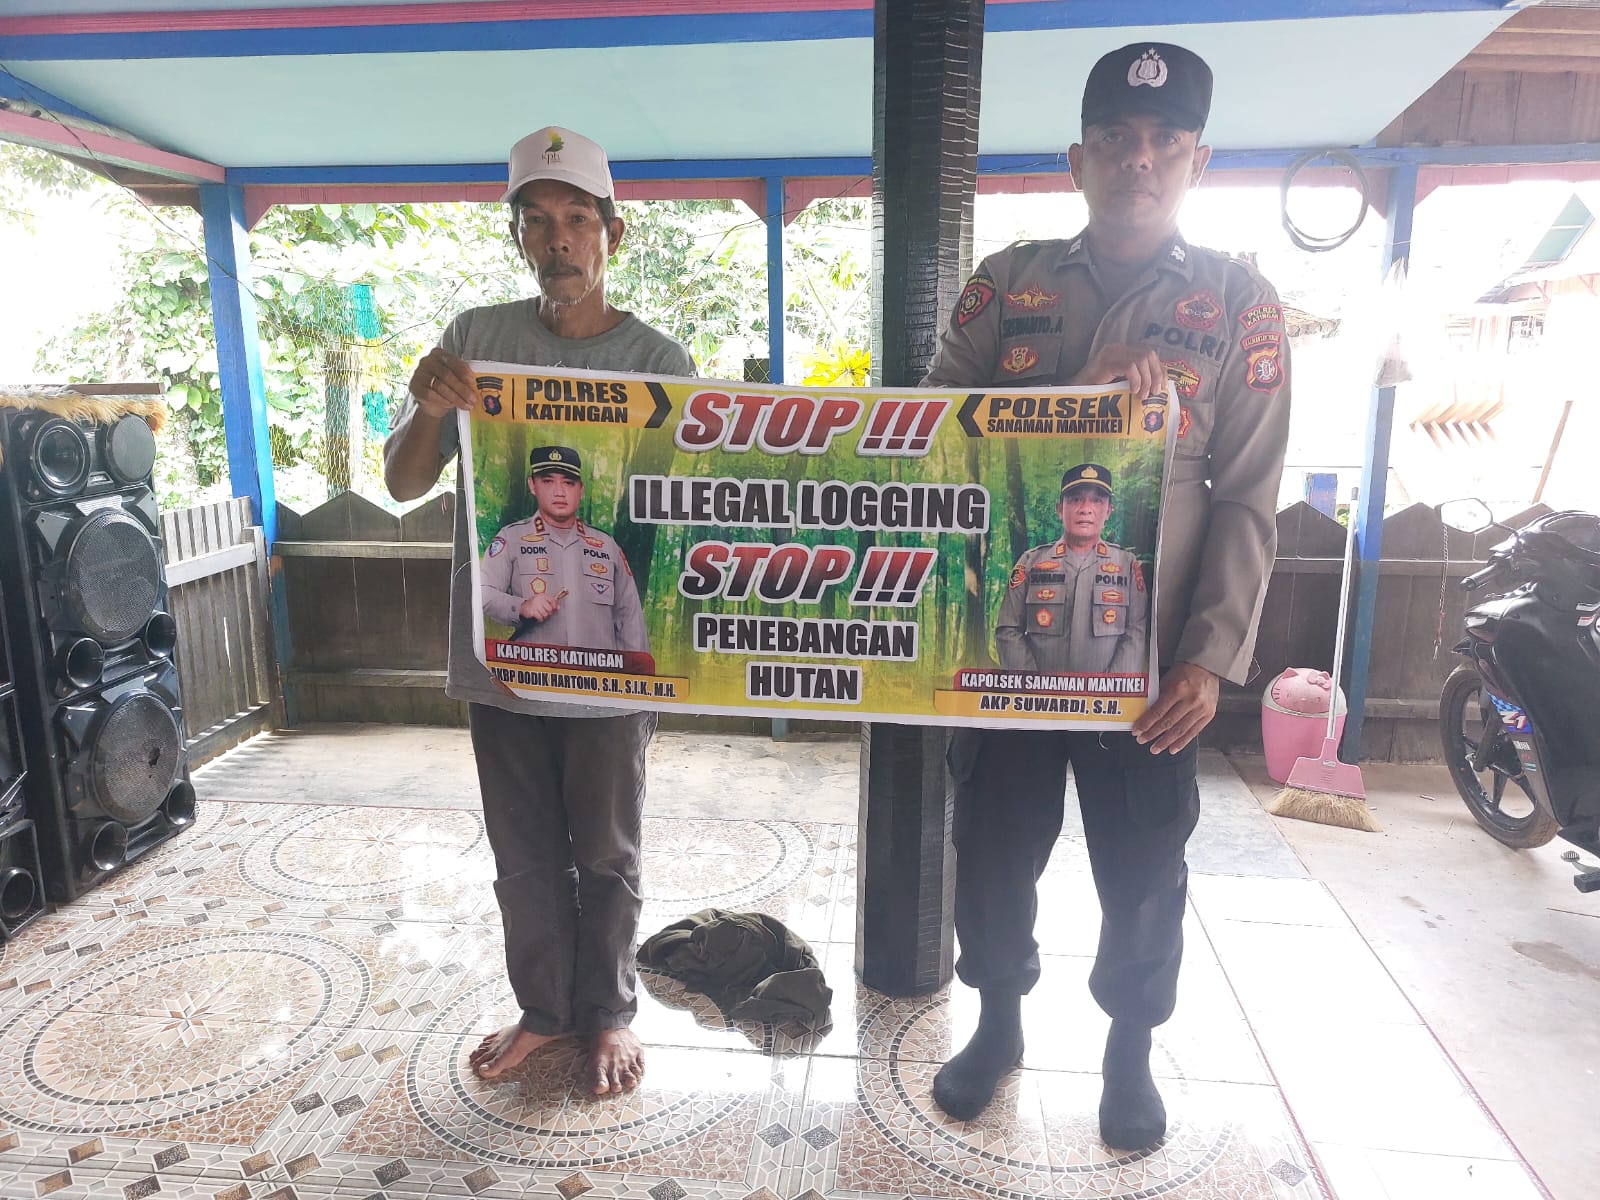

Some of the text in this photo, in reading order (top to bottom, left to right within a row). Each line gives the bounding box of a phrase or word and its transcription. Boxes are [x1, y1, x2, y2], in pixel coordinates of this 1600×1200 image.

[1144, 322, 1227, 362] POLRI
[525, 378, 628, 404] POLRES
[525, 403, 628, 424] KATINGAN
[988, 394, 1122, 419] POLSEK
[679, 392, 860, 450] STOP
[987, 418, 1123, 434] SANAMAN MANTIKEI
[633, 479, 987, 530] ILLEGAL LOGGING
[520, 546, 547, 554] DODIK
[583, 548, 610, 560] POLRI
[681, 544, 852, 600] STOP
[1095, 574, 1128, 587] POLRI
[697, 616, 914, 658] PENEBANGAN
[496, 643, 624, 669] KAPOLRES KATINGAN
[517, 671, 549, 686] DODIK
[551, 673, 600, 692] HARTONO,
[654, 682, 676, 698] M.H.
[750, 665, 858, 700] HUTAN
[961, 673, 1145, 693] KAPOLSEK SANAMAN MANTIKEI
[980, 695, 1122, 715] AKP SUWARDI, S.H.
